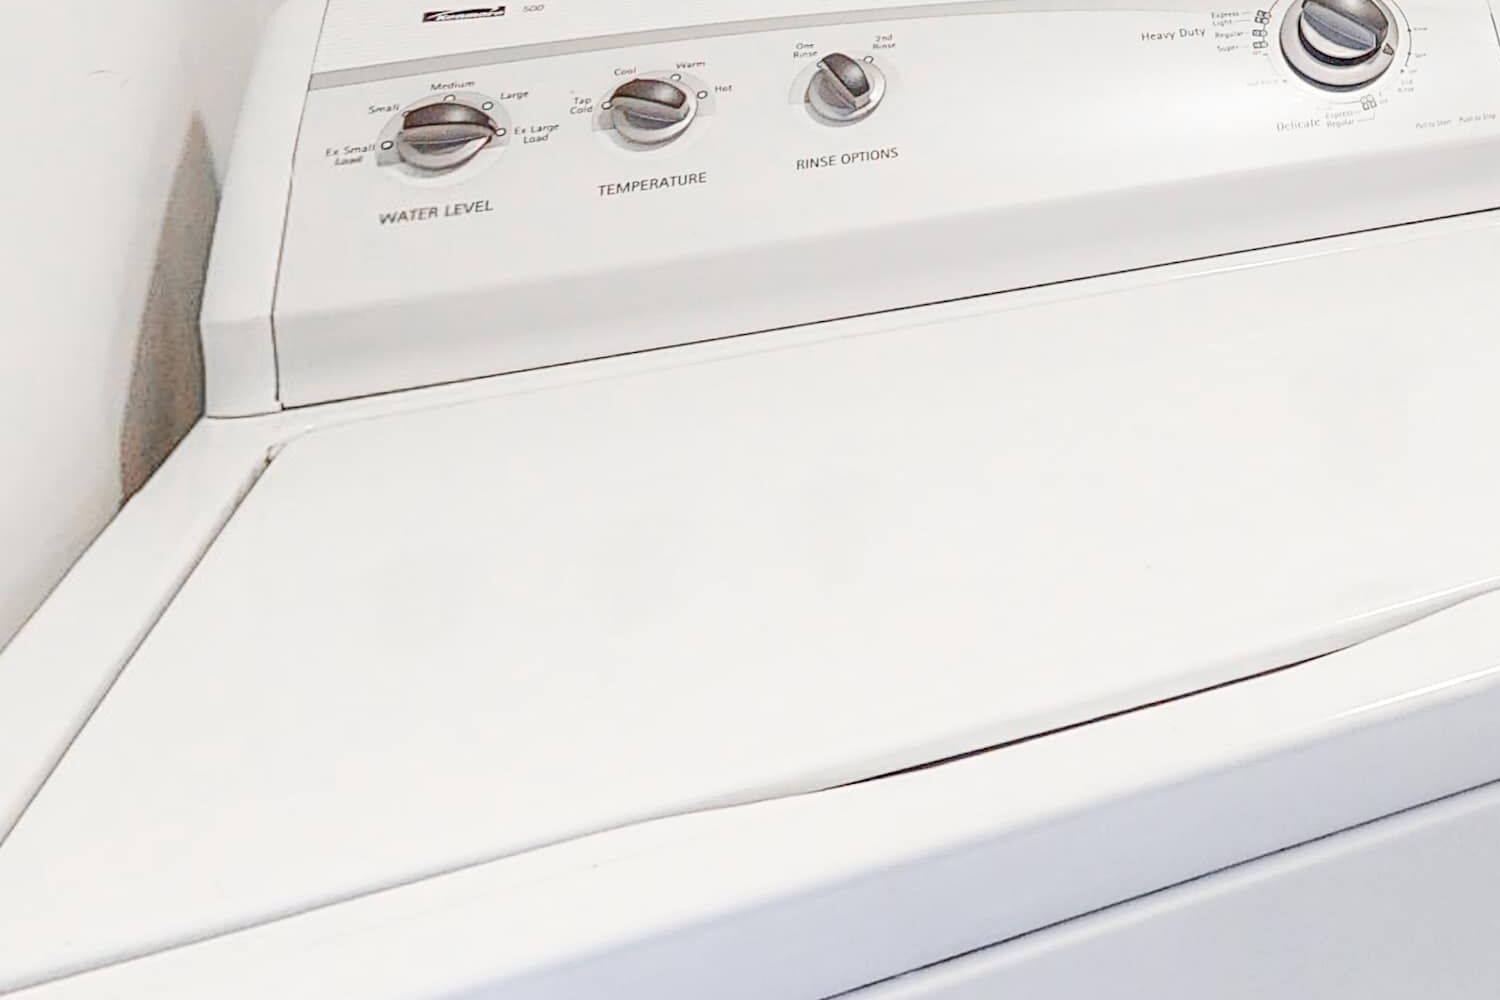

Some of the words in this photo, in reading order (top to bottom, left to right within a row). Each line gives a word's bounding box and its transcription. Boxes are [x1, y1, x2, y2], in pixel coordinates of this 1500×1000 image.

[1141, 30, 1176, 43] Heavy
[1178, 27, 1206, 38] Duty
[792, 50, 819, 59] Rinse
[675, 60, 706, 70] Warm
[613, 67, 637, 77] Cool
[430, 80, 476, 92] Medium
[714, 84, 733, 93] Hot
[500, 89, 529, 101] Large
[573, 96, 592, 106] Tap
[368, 103, 400, 115] Small
[569, 105, 593, 115] Cold
[514, 126, 527, 135] Ex
[530, 122, 560, 135] Large
[1275, 118, 1322, 133] Delicate
[523, 133, 550, 145] Load
[325, 148, 340, 157] Ex
[343, 143, 376, 155] Small
[334, 155, 364, 167] Load
[796, 154, 837, 171] RINSE
[840, 146, 899, 165] OPTIONS
[597, 171, 708, 197] TEMPERATURE
[378, 206, 440, 226] WATER
[444, 199, 494, 218] LEVEL
